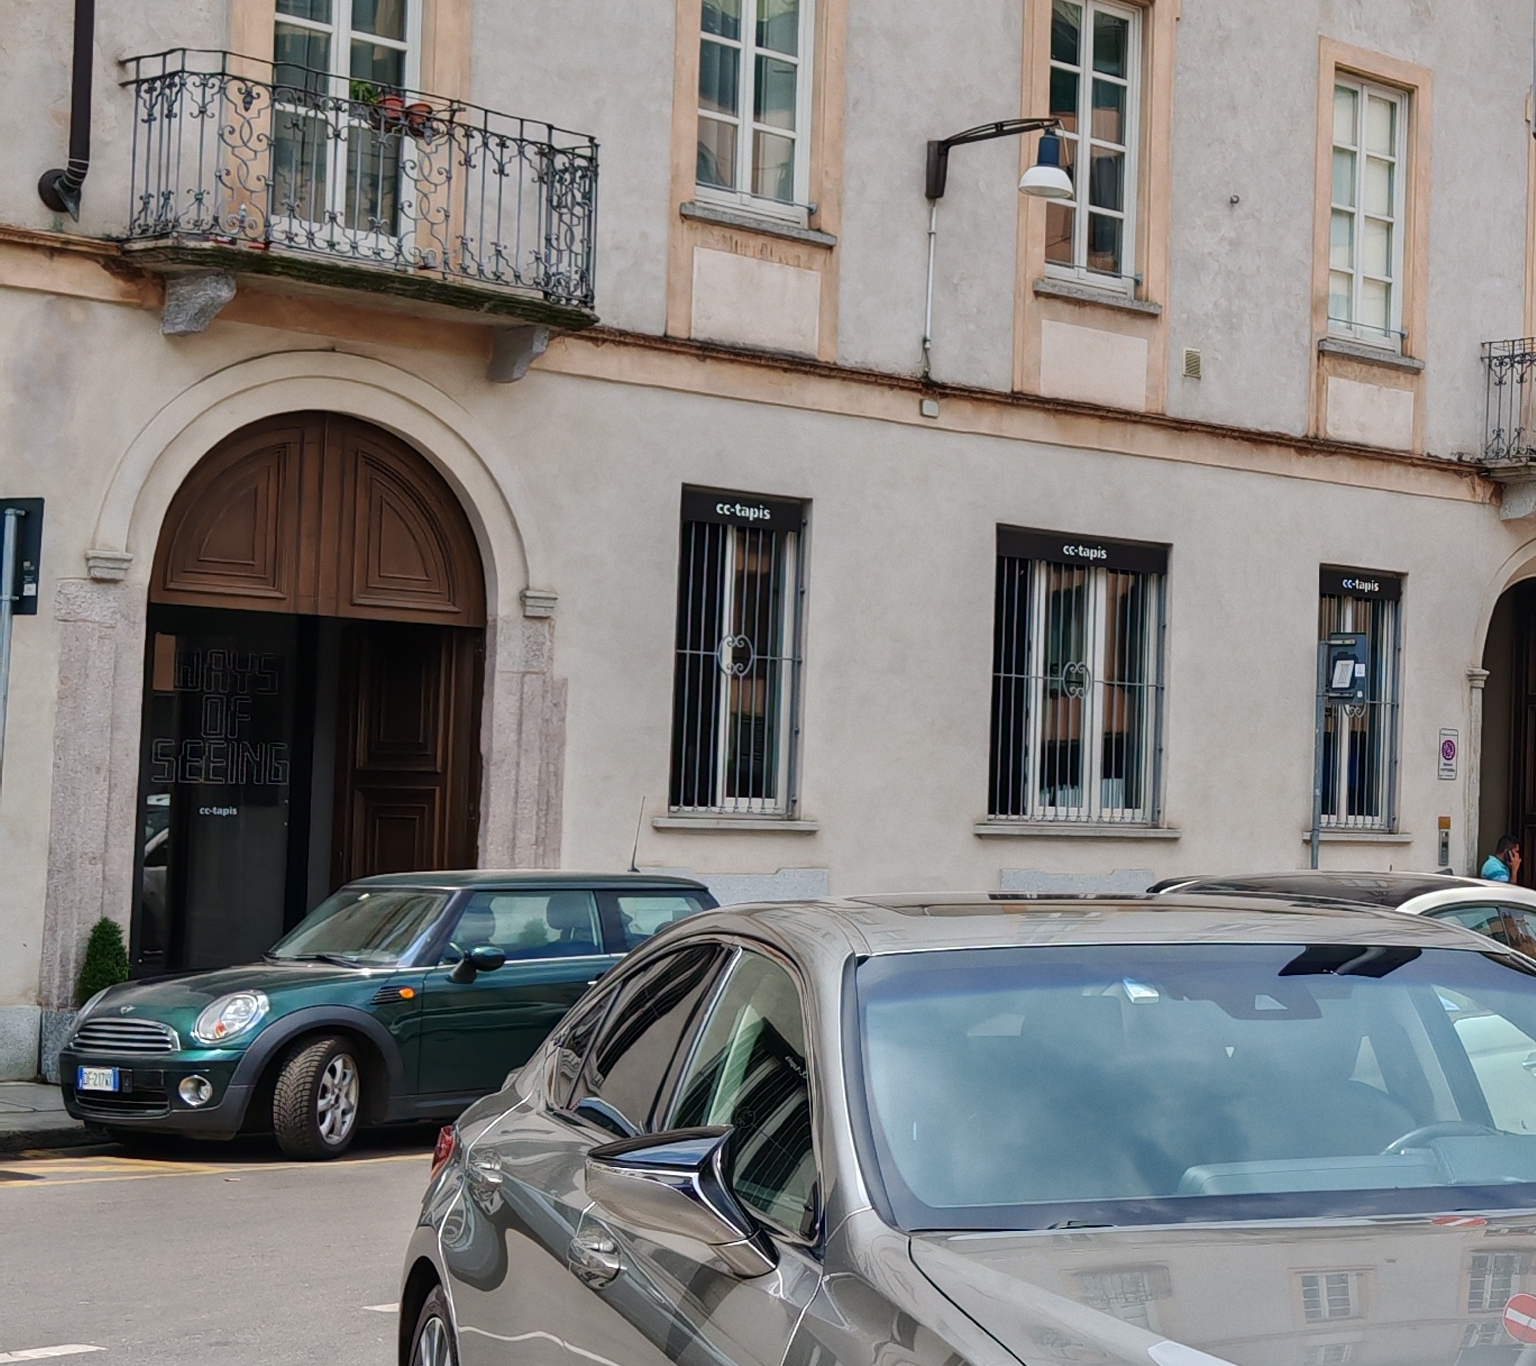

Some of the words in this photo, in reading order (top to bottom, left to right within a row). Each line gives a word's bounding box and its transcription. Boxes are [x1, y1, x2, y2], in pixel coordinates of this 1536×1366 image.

[716, 503, 771, 520] cc-tapis
[1063, 545, 1107, 560] cc-tapis
[1342, 579, 1379, 592] cc-tapis
[175, 649, 278, 695] WAYS
[202, 695, 252, 738] OF
[151, 738, 289, 785] SEEING
[199, 806, 238, 817] cc-tapis
